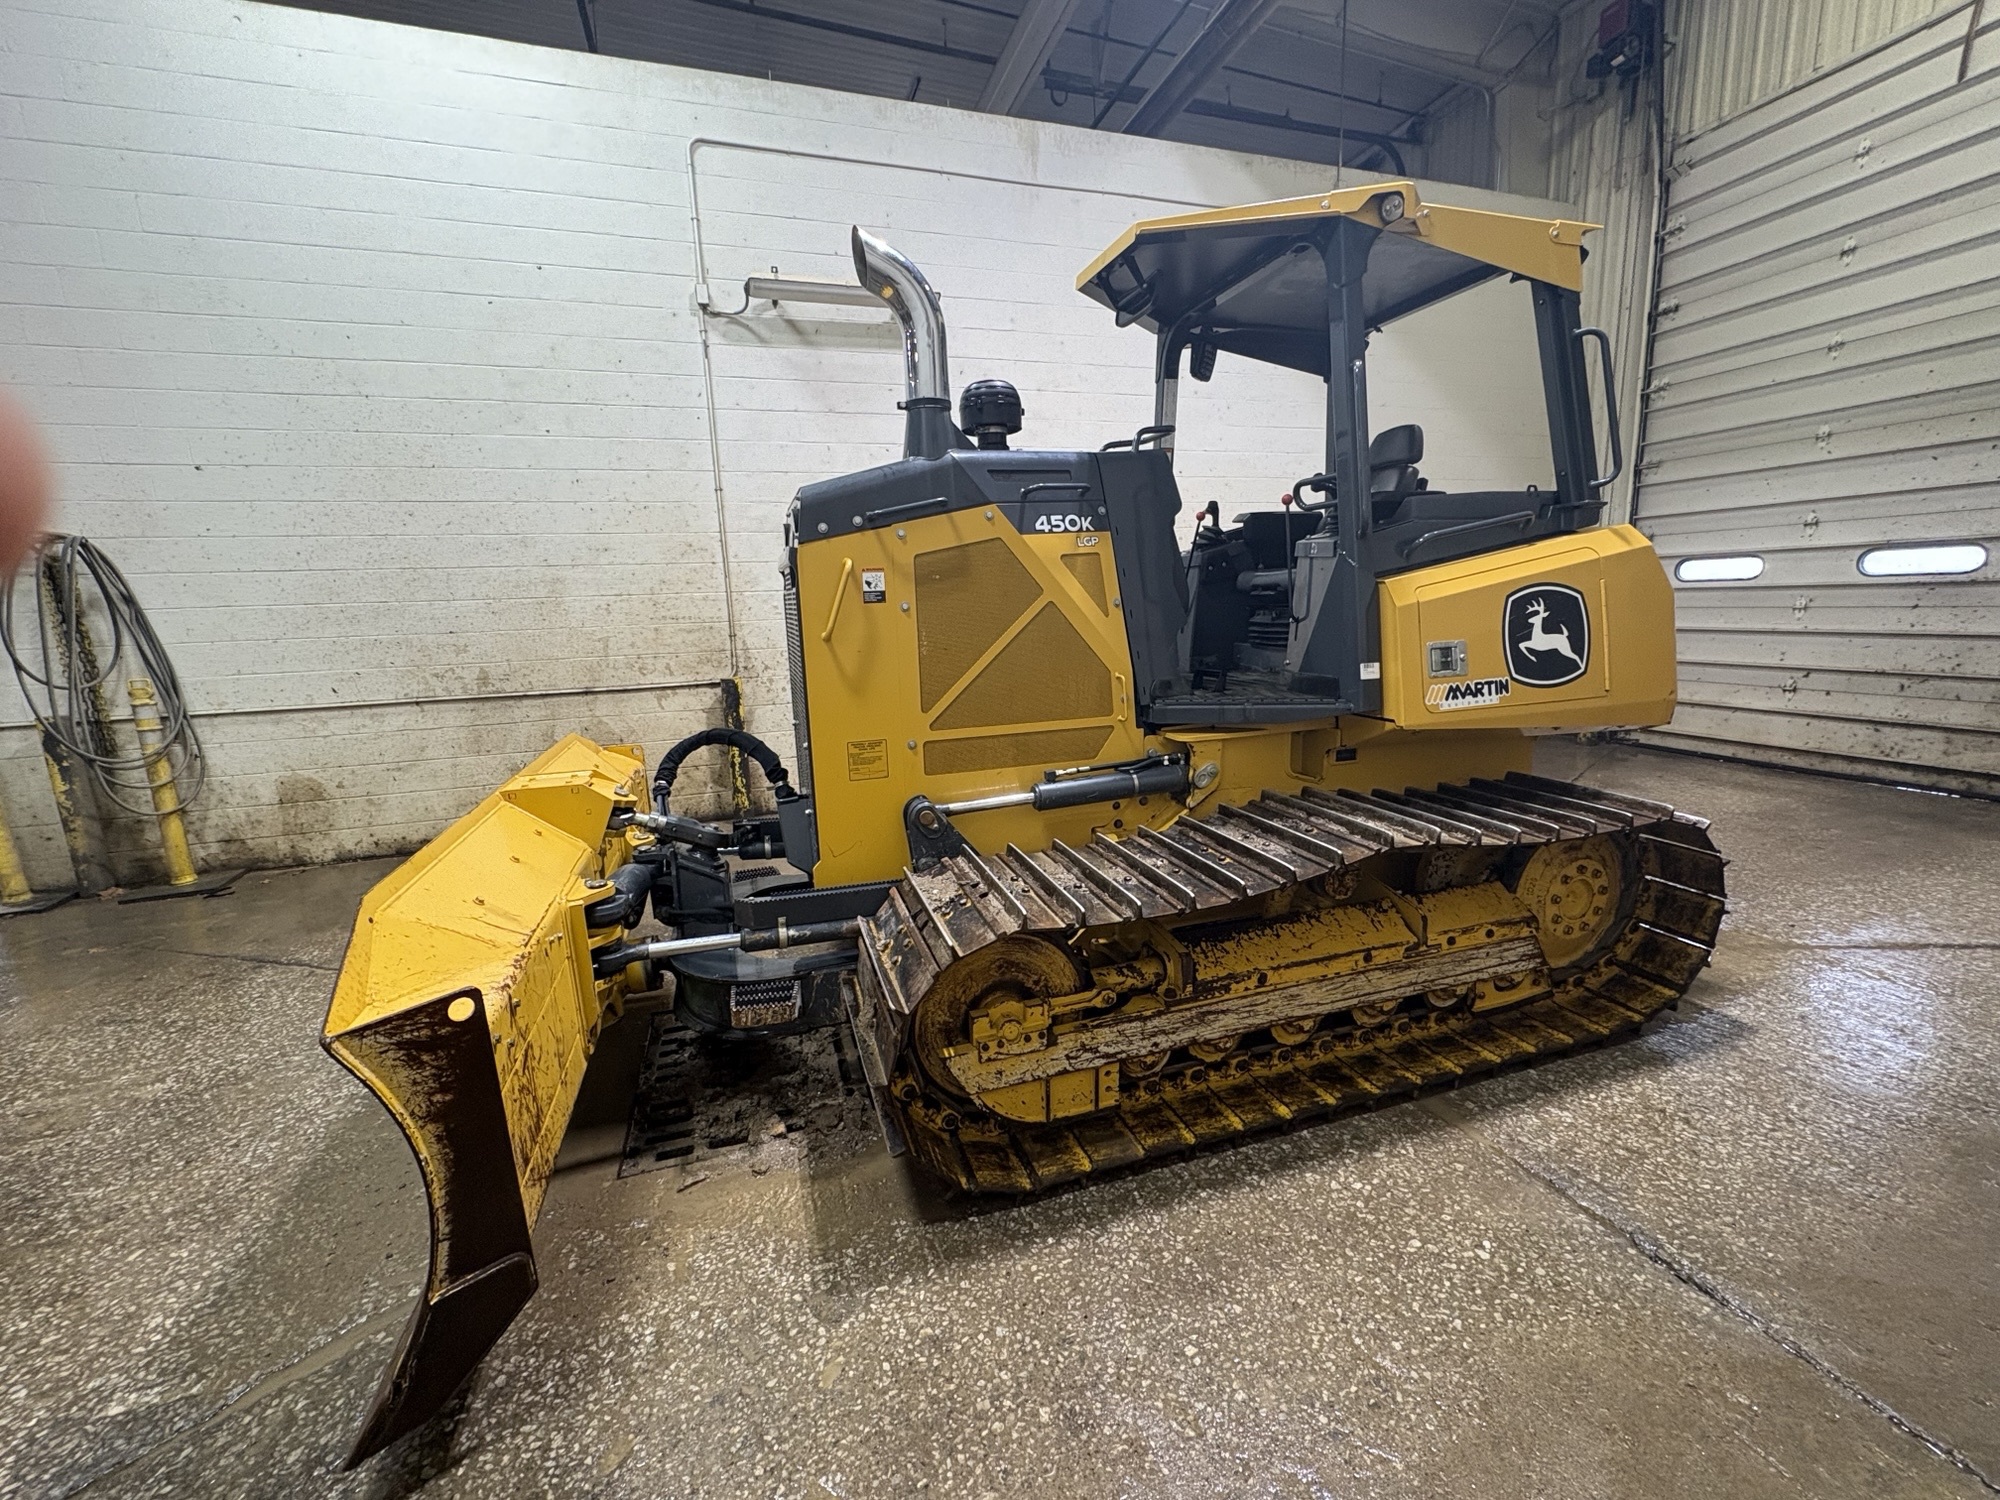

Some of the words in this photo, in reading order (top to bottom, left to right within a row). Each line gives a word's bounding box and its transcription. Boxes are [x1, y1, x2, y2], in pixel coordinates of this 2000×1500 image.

[1035, 514, 1095, 533] 450K
[1077, 536, 1099, 547] LGP
[1445, 678, 1510, 702] MARTIN
